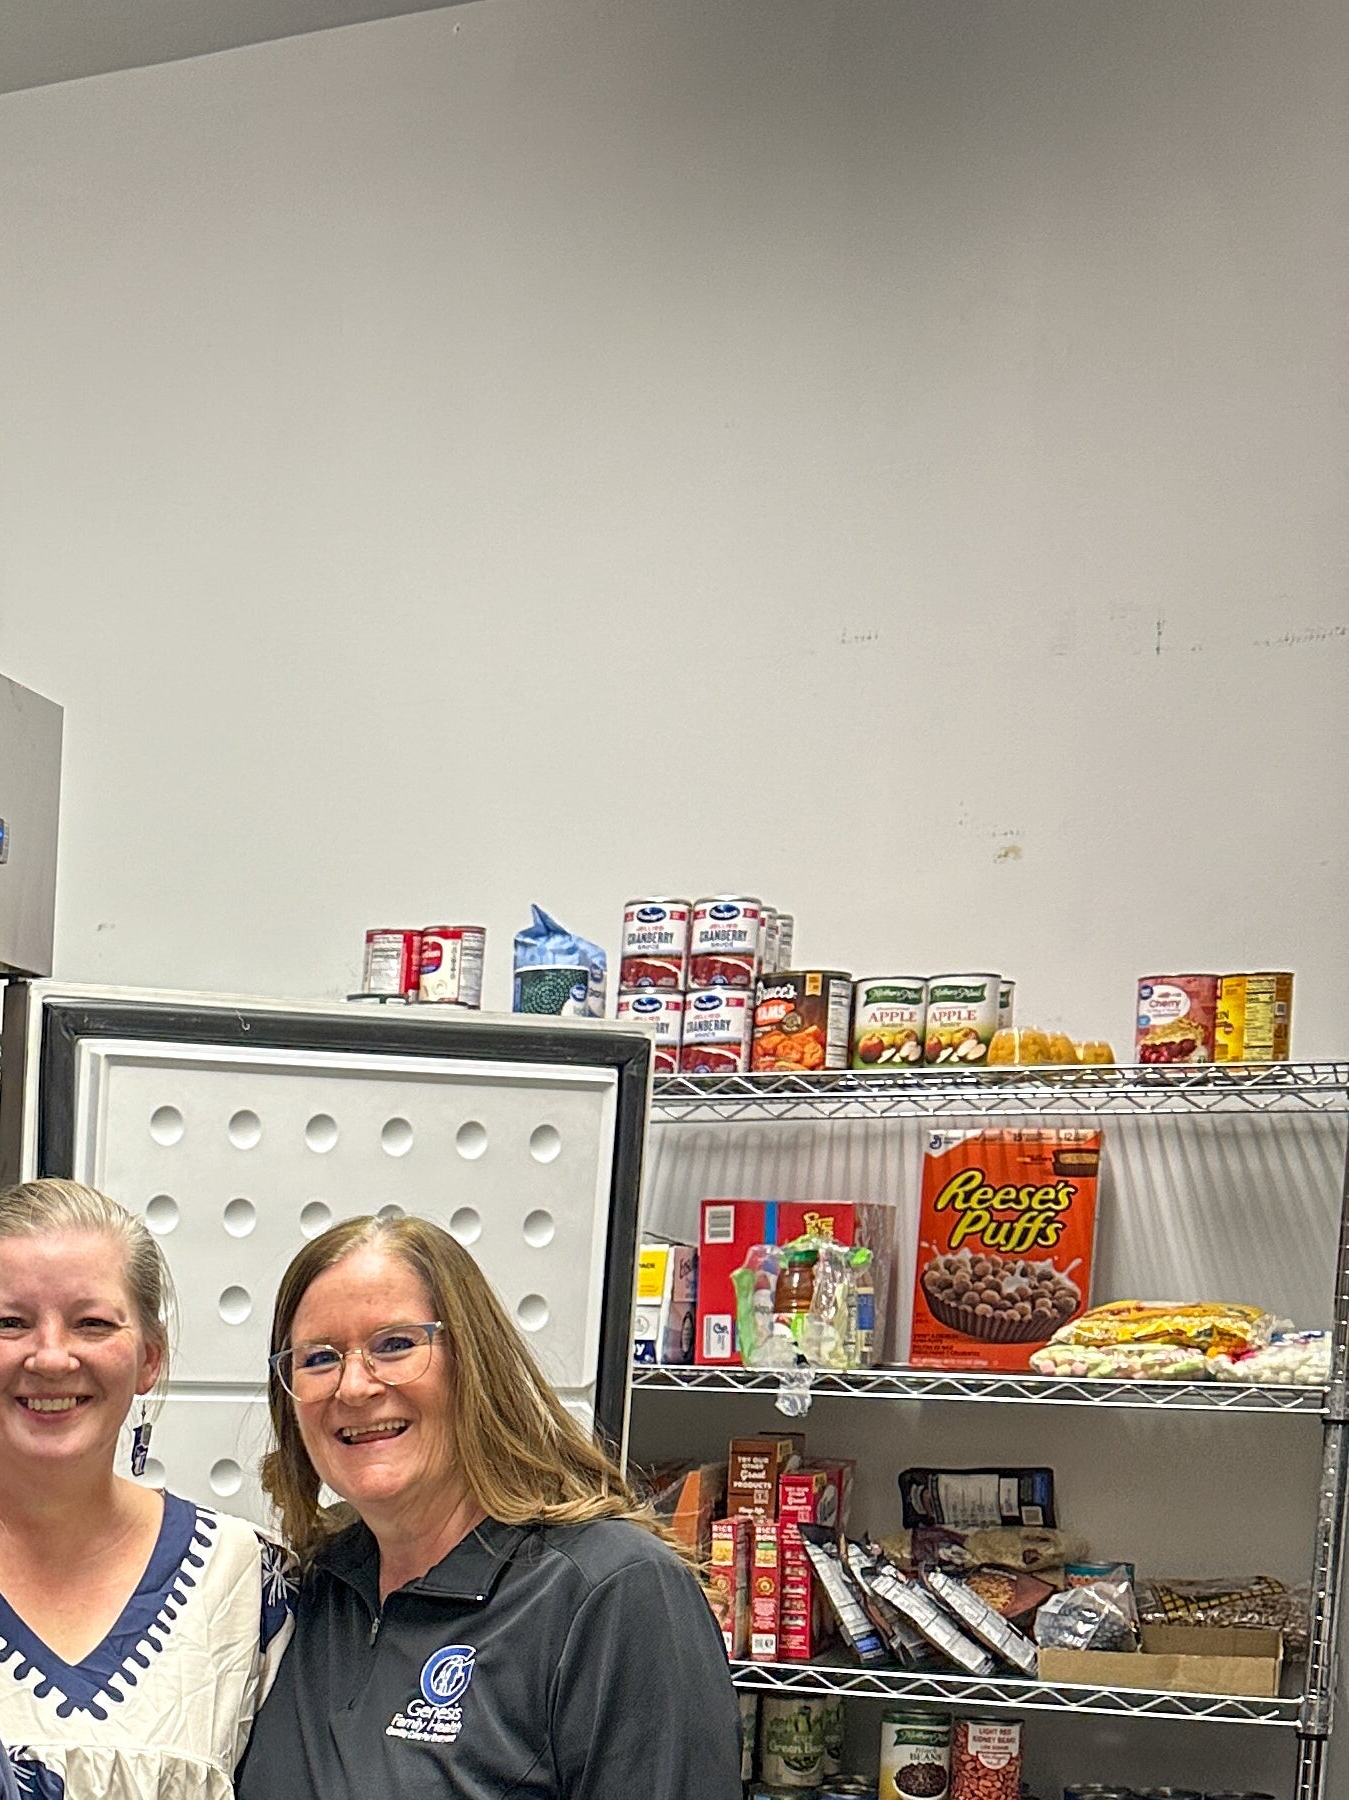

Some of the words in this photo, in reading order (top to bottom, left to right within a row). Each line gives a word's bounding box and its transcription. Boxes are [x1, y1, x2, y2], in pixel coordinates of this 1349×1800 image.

[627, 931, 675, 946] CRANBERRY
[699, 929, 748, 943] CRANBERRY
[1150, 1000, 1181, 1010] Cherry
[868, 1011, 917, 1024] APPLE
[930, 1009, 978, 1022] APPLE
[686, 1020, 732, 1033] CRANBERRY
[935, 1170, 1077, 1211] Reese's
[950, 1209, 1063, 1253] Puffs
[733, 1481, 772, 1489] PRODUCTS
[407, 1699, 463, 1721] Genesis
[391, 1712, 427, 1733] Family
[427, 1719, 463, 1734] Health
[978, 1727, 997, 1736] LIGHT
[973, 1736, 996, 1744] KIDNEY
[910, 1753, 942, 1761] BEANS
